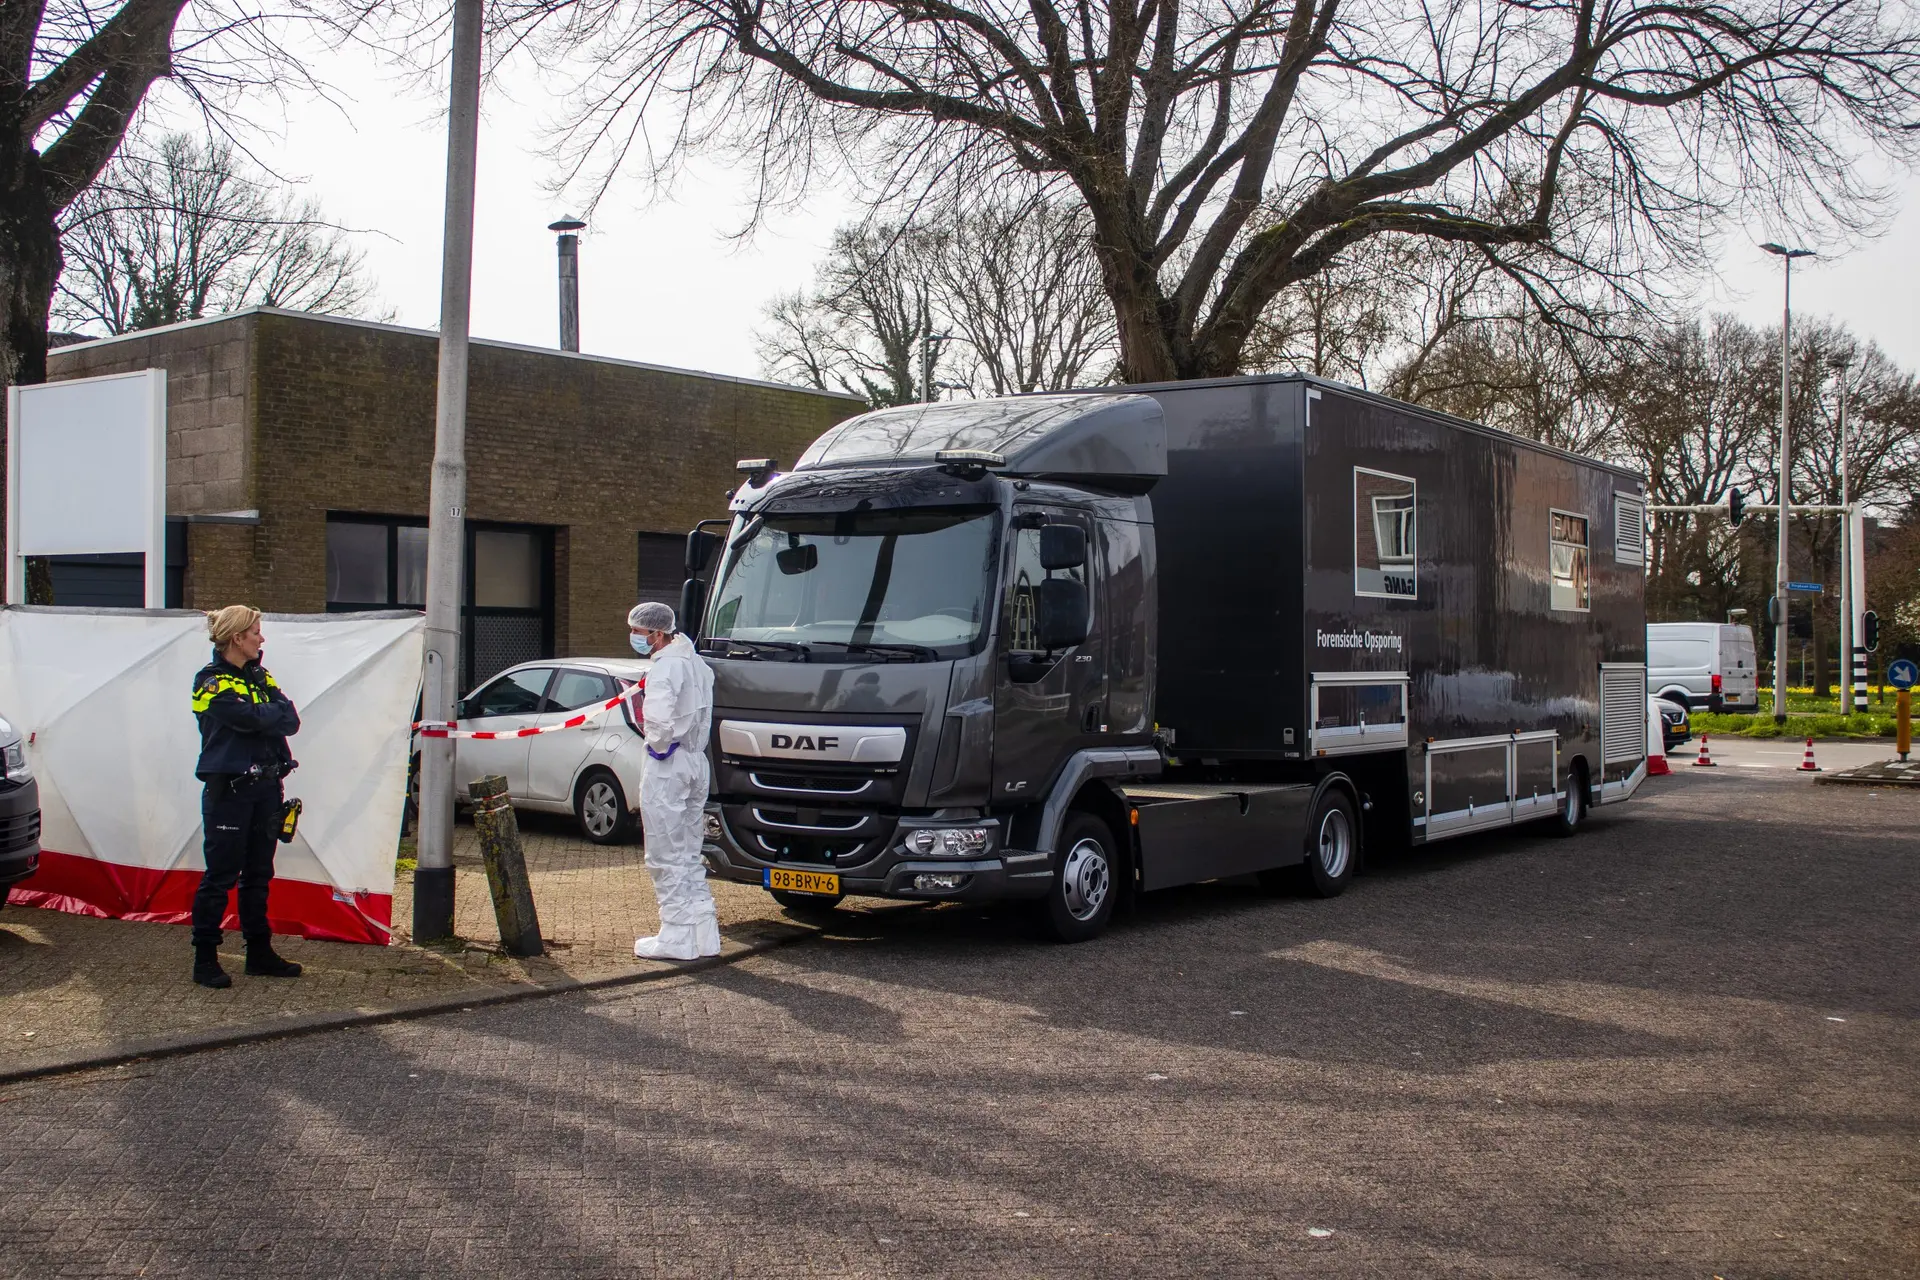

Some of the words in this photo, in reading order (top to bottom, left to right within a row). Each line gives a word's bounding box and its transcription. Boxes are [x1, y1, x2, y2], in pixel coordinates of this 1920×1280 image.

[1317, 629, 1362, 648] Forensische
[1364, 630, 1402, 653] Opsporing
[771, 734, 839, 751] DAF
[1005, 781, 1027, 792] LF
[774, 872, 835, 891] 98-BRV-6
